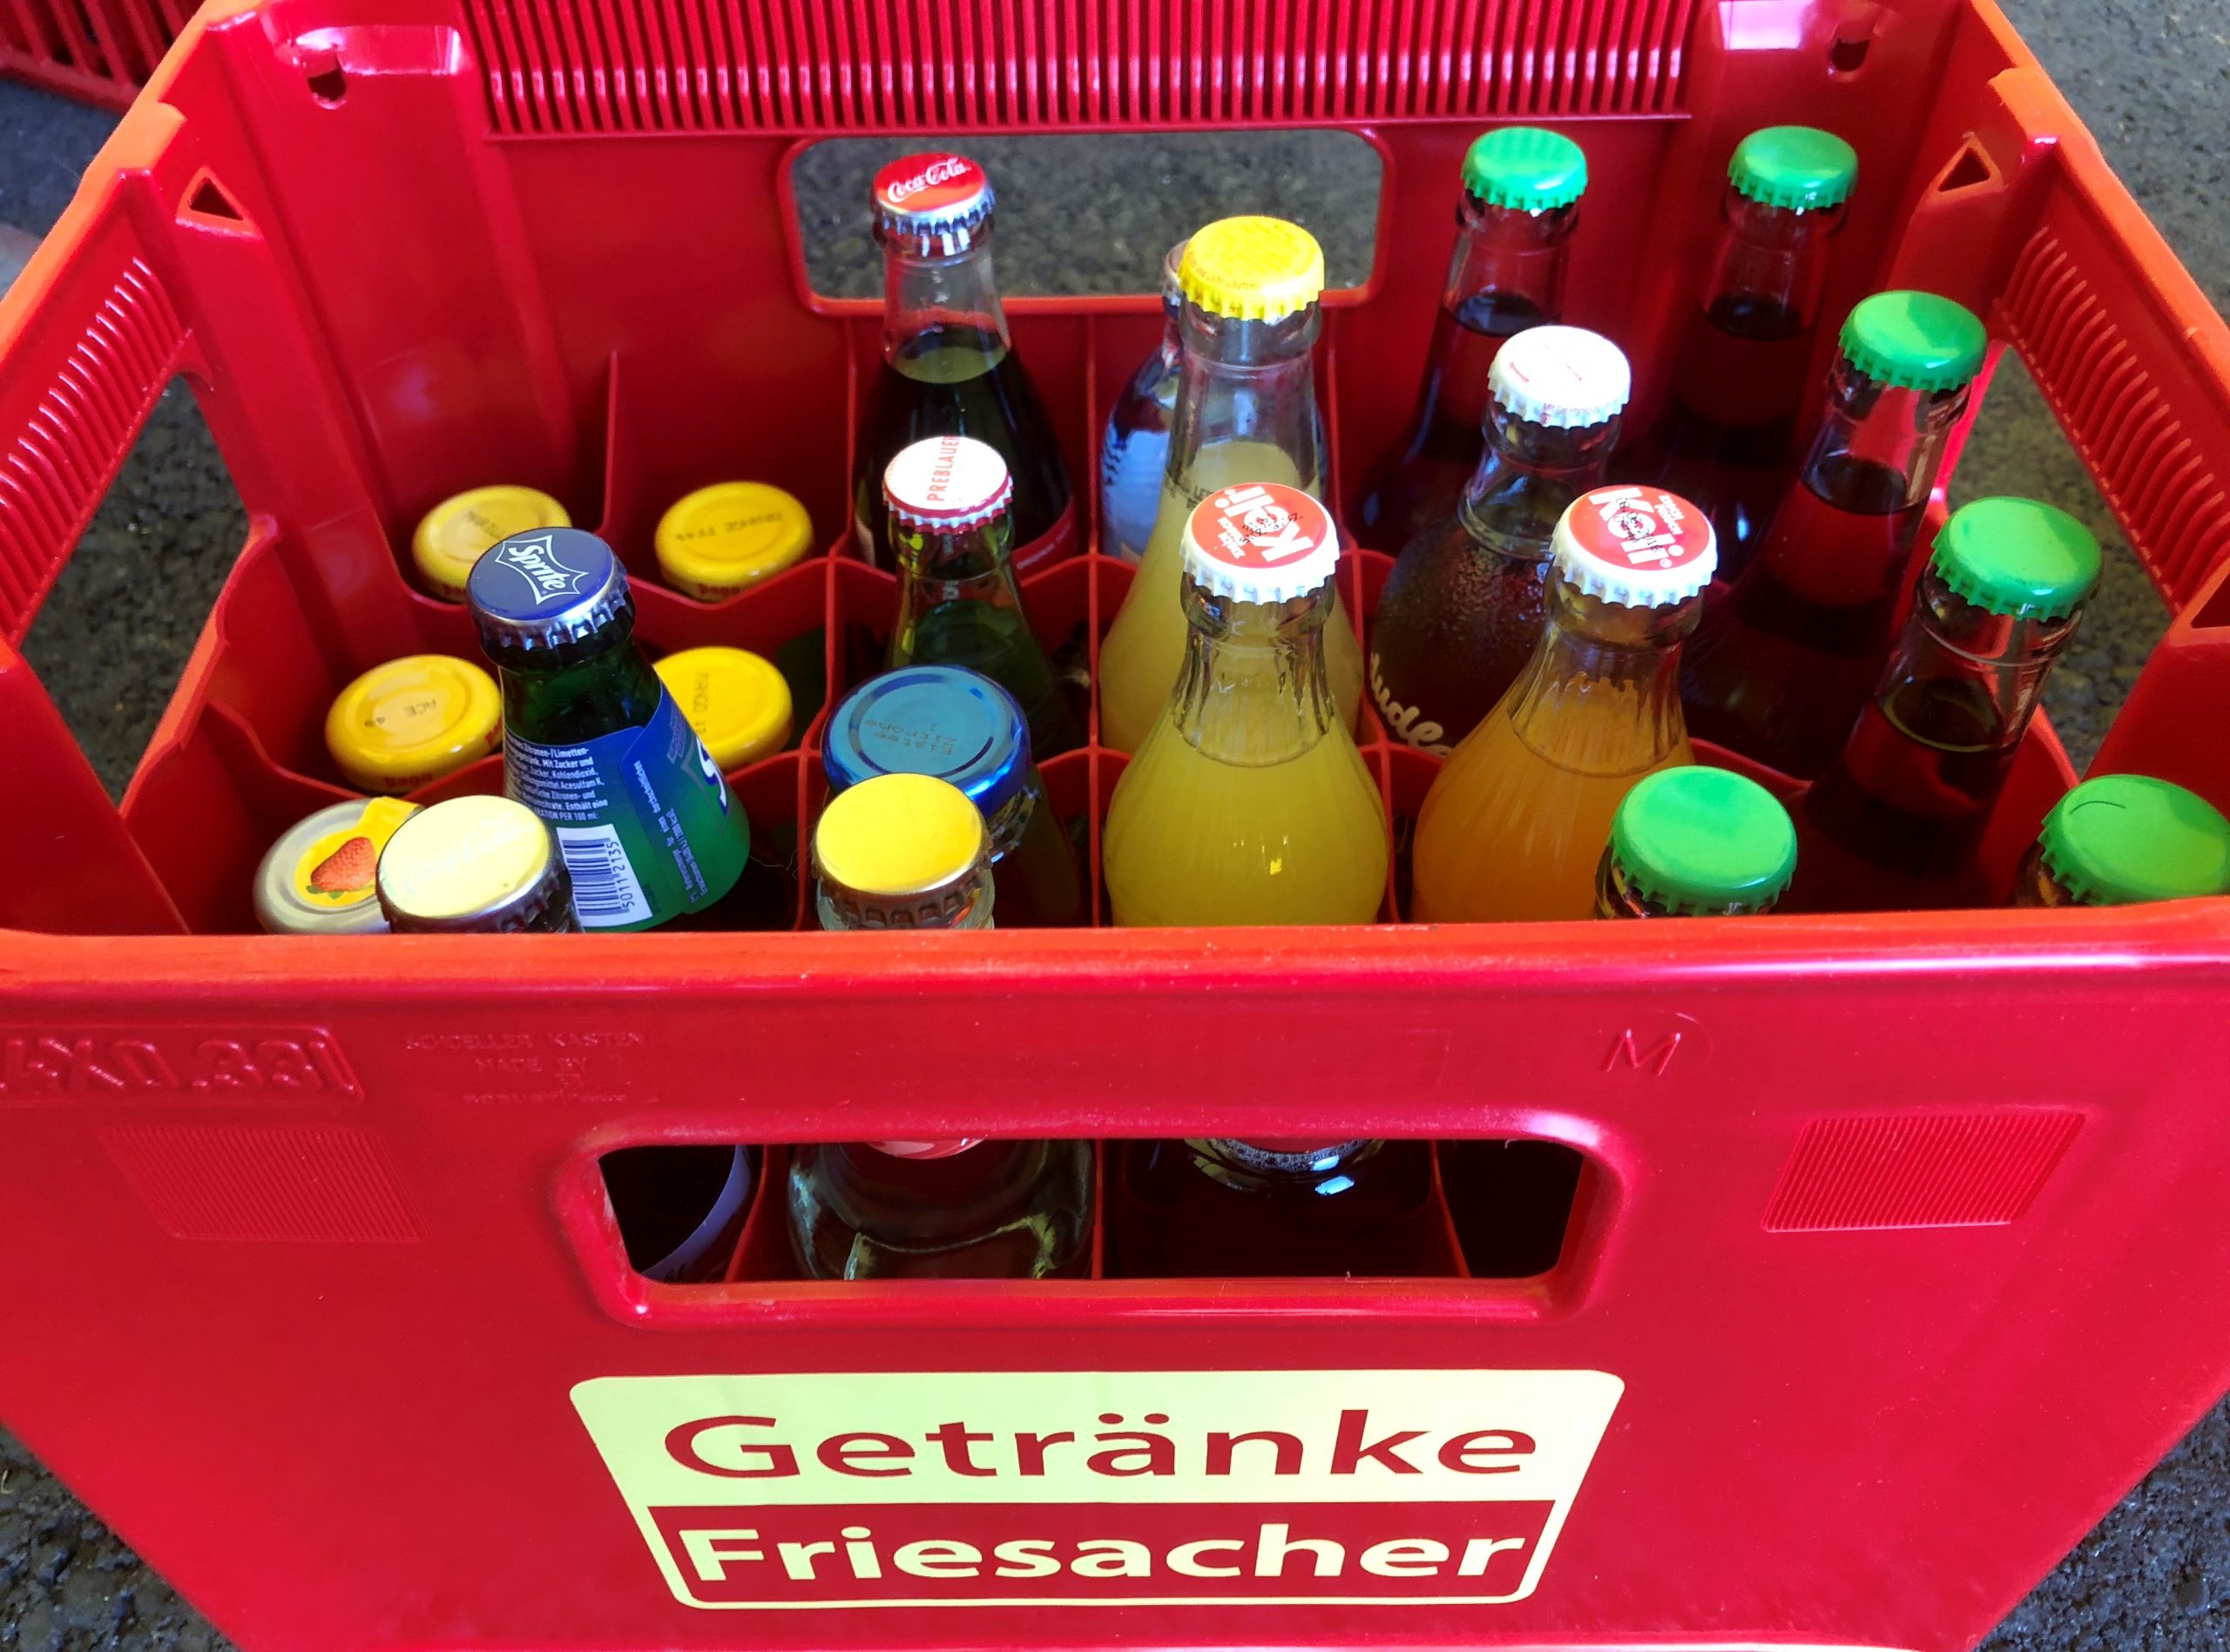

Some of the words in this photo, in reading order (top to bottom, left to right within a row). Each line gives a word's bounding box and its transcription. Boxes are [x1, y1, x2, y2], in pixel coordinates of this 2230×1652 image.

[888, 157, 967, 203] Coca-Cola
[1214, 486, 1314, 562] Keli
[1588, 487, 1685, 564] Keli
[508, 544, 571, 590] Sprite
[606, 841, 625, 872] 2135
[617, 878, 635, 907] 5011
[666, 1407, 1537, 1480] Getränke
[678, 1522, 1526, 1581] Friesacher
